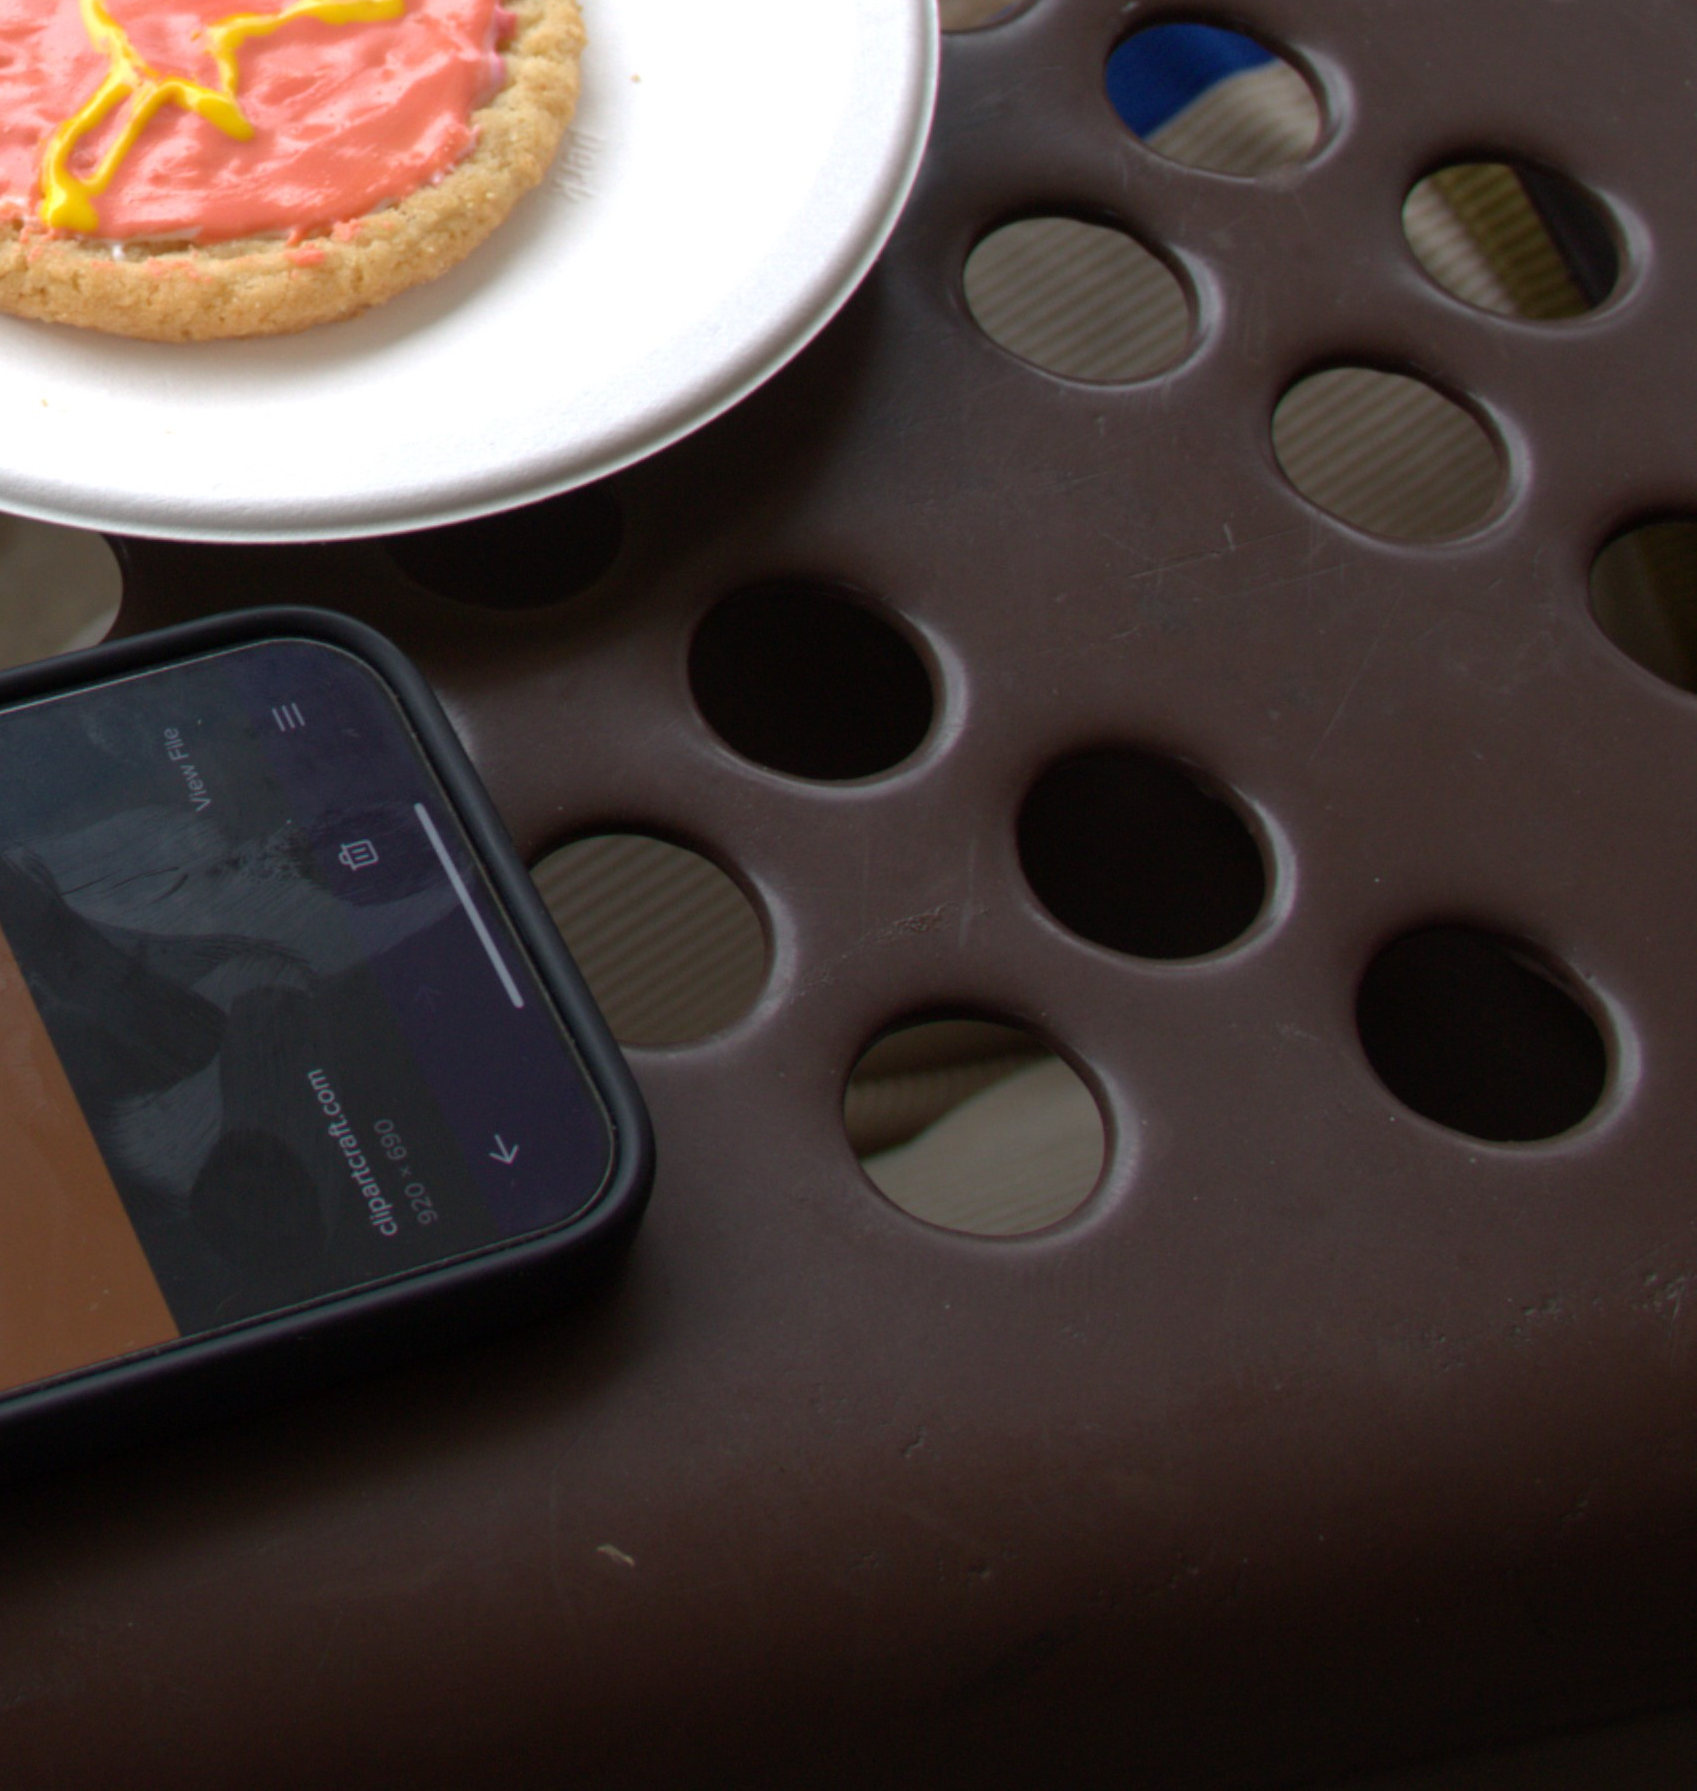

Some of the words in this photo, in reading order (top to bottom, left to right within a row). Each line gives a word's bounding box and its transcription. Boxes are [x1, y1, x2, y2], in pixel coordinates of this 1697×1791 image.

[163, 727, 190, 761] File
[180, 764, 211, 812] View
[307, 1068, 398, 1237] clipartcraft.com
[373, 1118, 407, 1161] 690
[404, 1182, 439, 1225] 920
